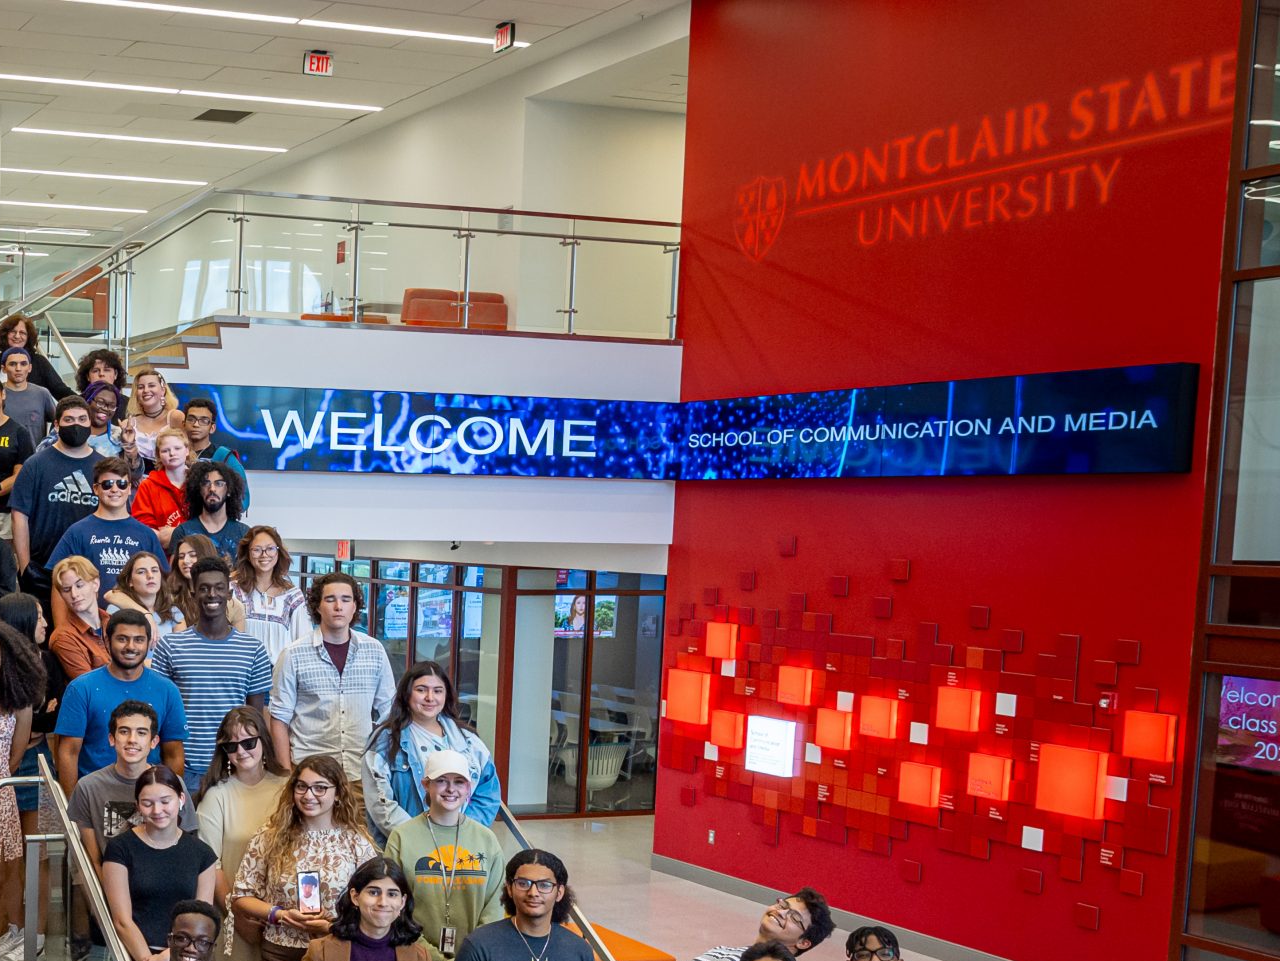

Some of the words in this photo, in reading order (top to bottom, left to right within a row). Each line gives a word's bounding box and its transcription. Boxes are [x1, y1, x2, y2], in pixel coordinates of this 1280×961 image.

[496, 26, 510, 48] EXIT
[309, 55, 330, 73] EXIT
[795, 101, 1050, 202] MONTCLAIR
[1068, 49, 1237, 141] STATE
[857, 157, 1121, 247] UNIVERSITY
[261, 408, 597, 458] WELCOME
[688, 431, 765, 449] SCHOOL
[767, 428, 795, 445] OF
[799, 417, 992, 444] COMMUNICATION
[997, 414, 1057, 435] AND
[1063, 409, 1159, 432] MEDIA
[48, 489, 99, 507] adidas
[112, 535, 124, 544] The
[337, 541, 349, 558] EXIT
[1221, 685, 1280, 708] elco
[1228, 713, 1277, 734] class
